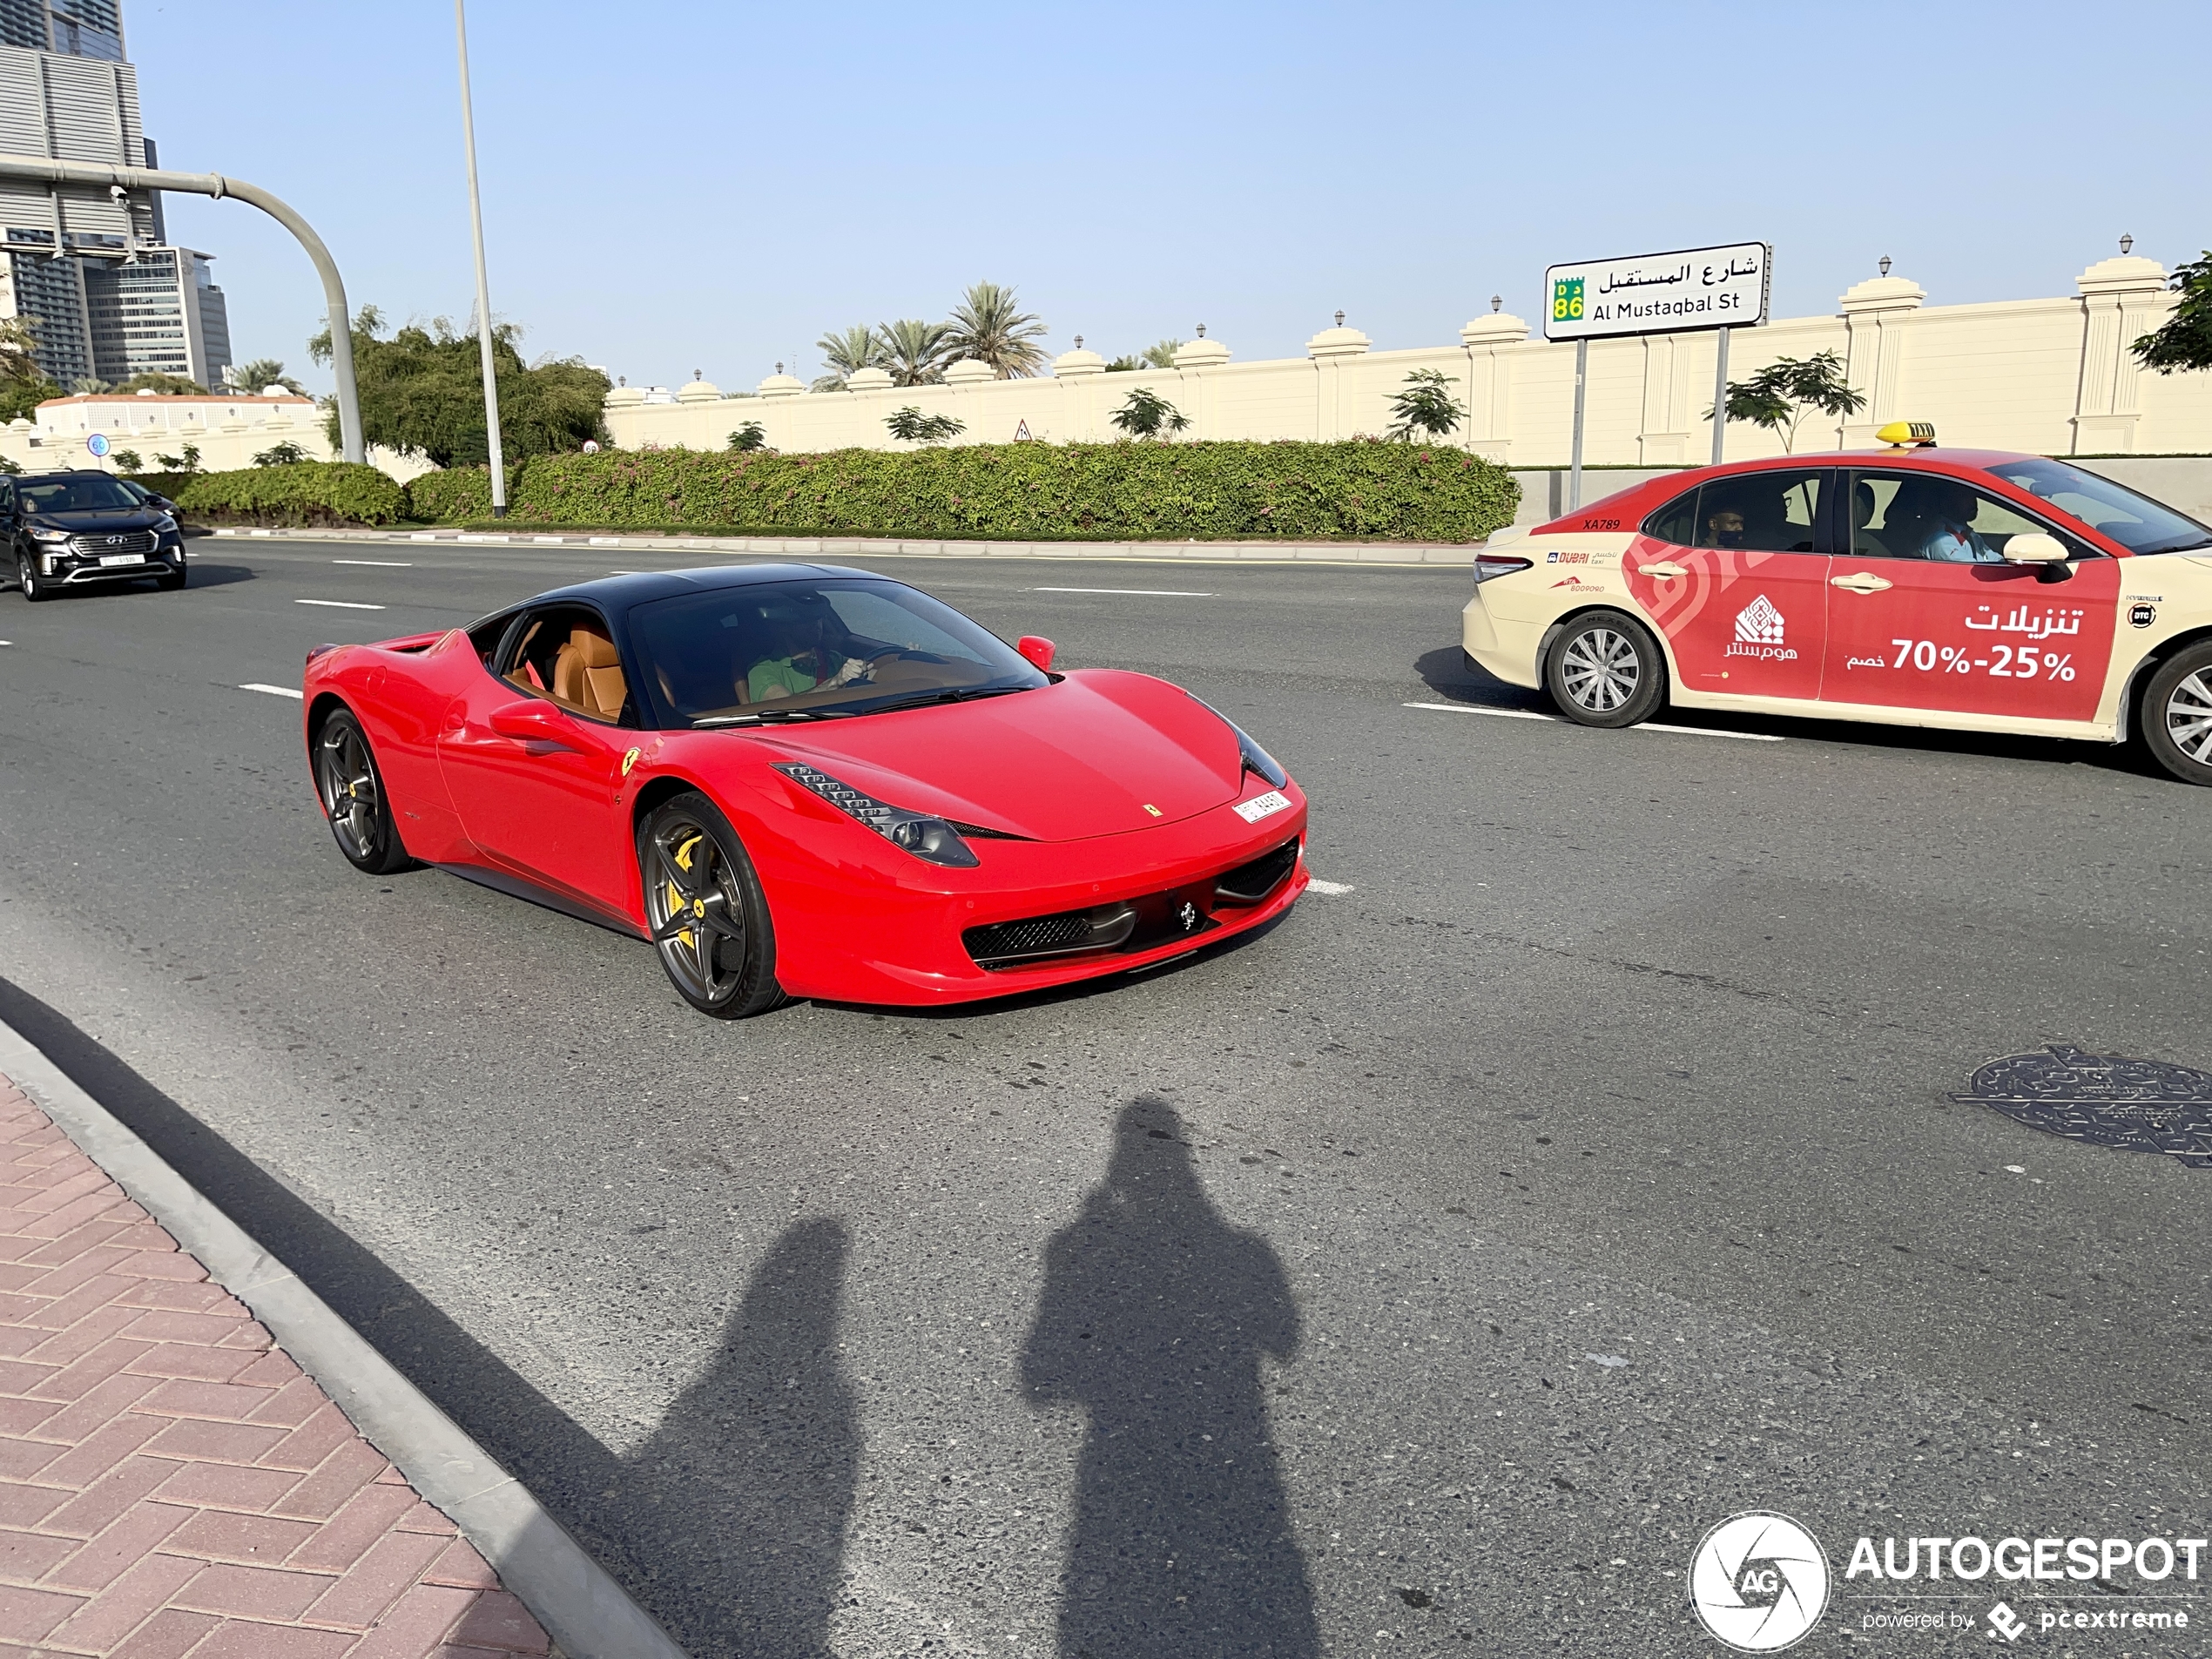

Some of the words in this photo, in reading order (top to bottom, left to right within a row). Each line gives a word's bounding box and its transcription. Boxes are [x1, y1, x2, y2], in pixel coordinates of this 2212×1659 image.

[1599, 263, 1691, 294] المستقبل
[1702, 257, 1758, 286] شارع
[1558, 285, 1568, 296] D
[1554, 296, 1583, 319] 86
[1593, 304, 1611, 321] Al
[1617, 295, 1712, 320] Mustaqbal
[1718, 292, 1740, 309] St
[1910, 423, 1932, 437] TAXI
[92, 441, 105, 449] 60
[1582, 519, 1621, 530] XA789
[1559, 552, 1590, 564] DUBAI
[1587, 616, 1635, 634] NEXEN
[1965, 604, 2084, 640] تنزيلات
[1723, 643, 1760, 658] سنتر
[1760, 649, 1797, 662] هوم
